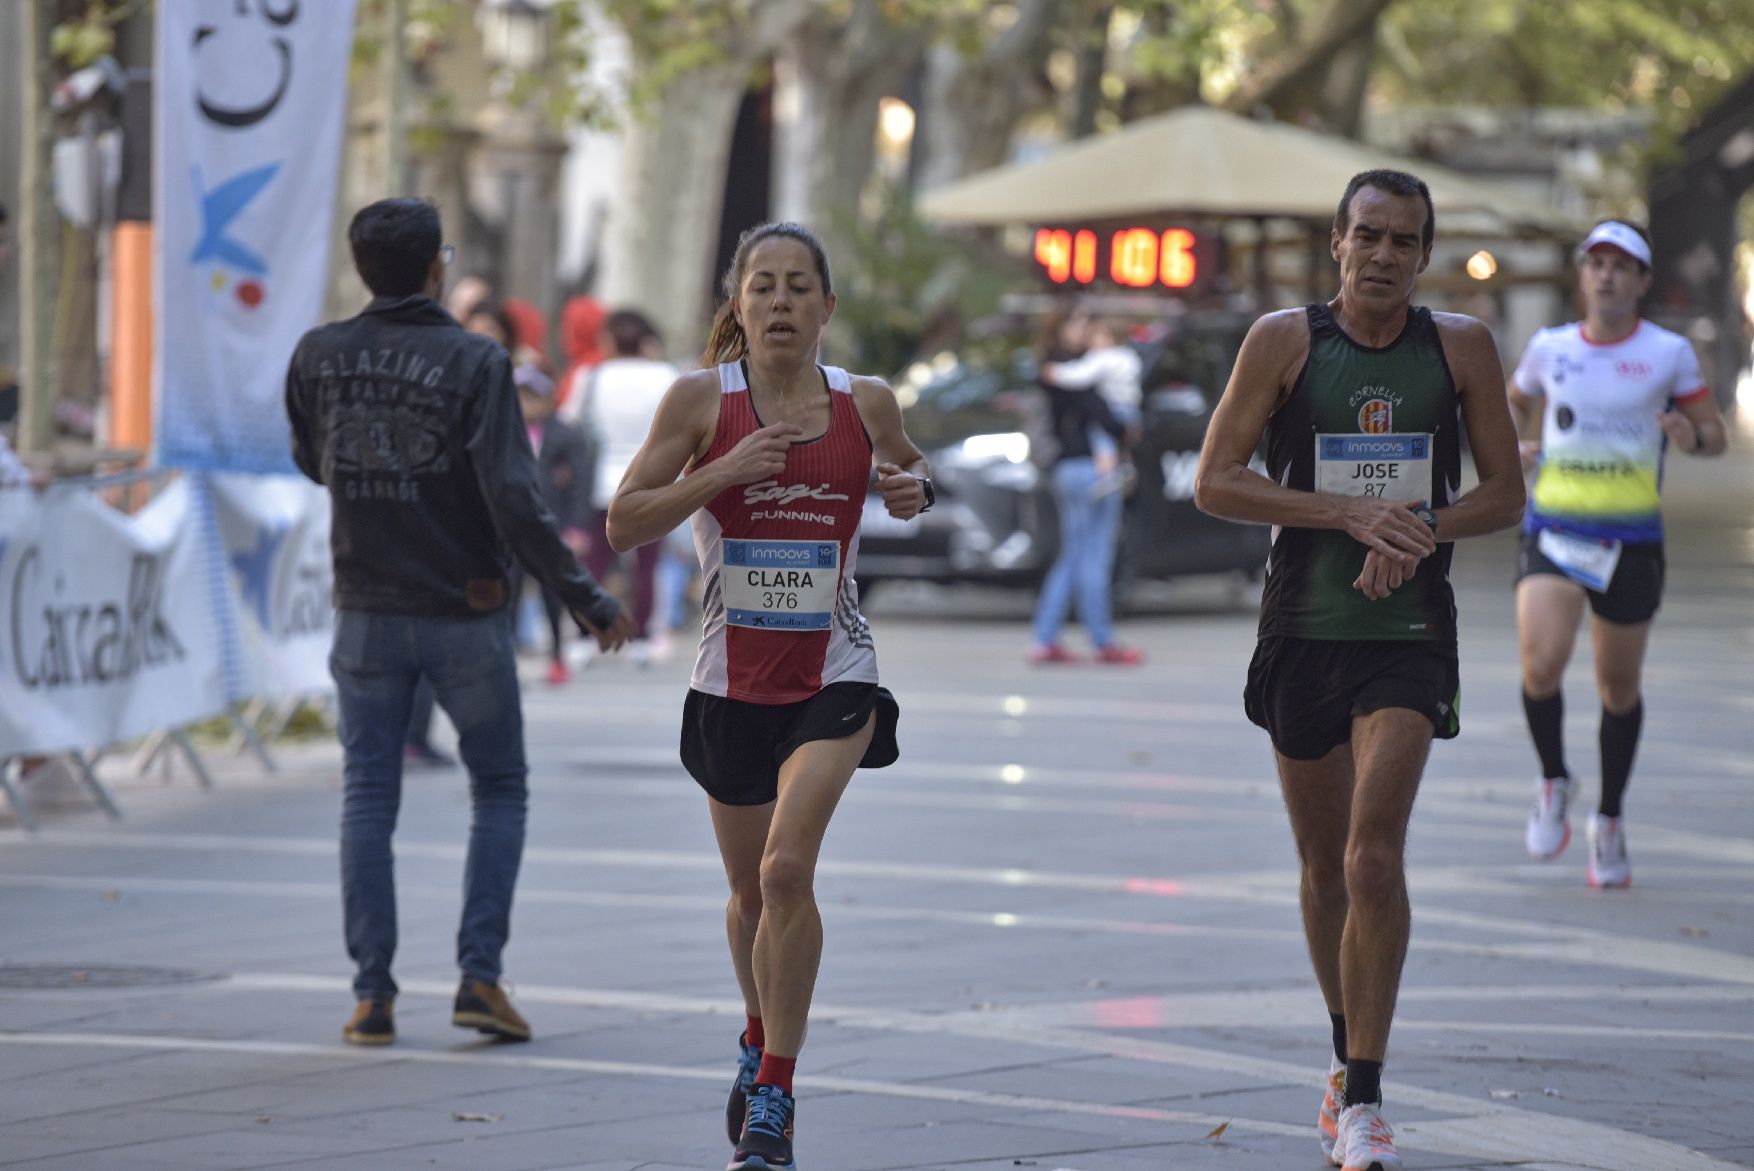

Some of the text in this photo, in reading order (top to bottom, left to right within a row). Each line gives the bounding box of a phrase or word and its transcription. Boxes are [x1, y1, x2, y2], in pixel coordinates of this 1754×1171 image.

[1351, 463, 1399, 479] JOSE
[1364, 483, 1386, 498] 87
[747, 570, 814, 588] CLARA
[762, 592, 798, 609] 376
